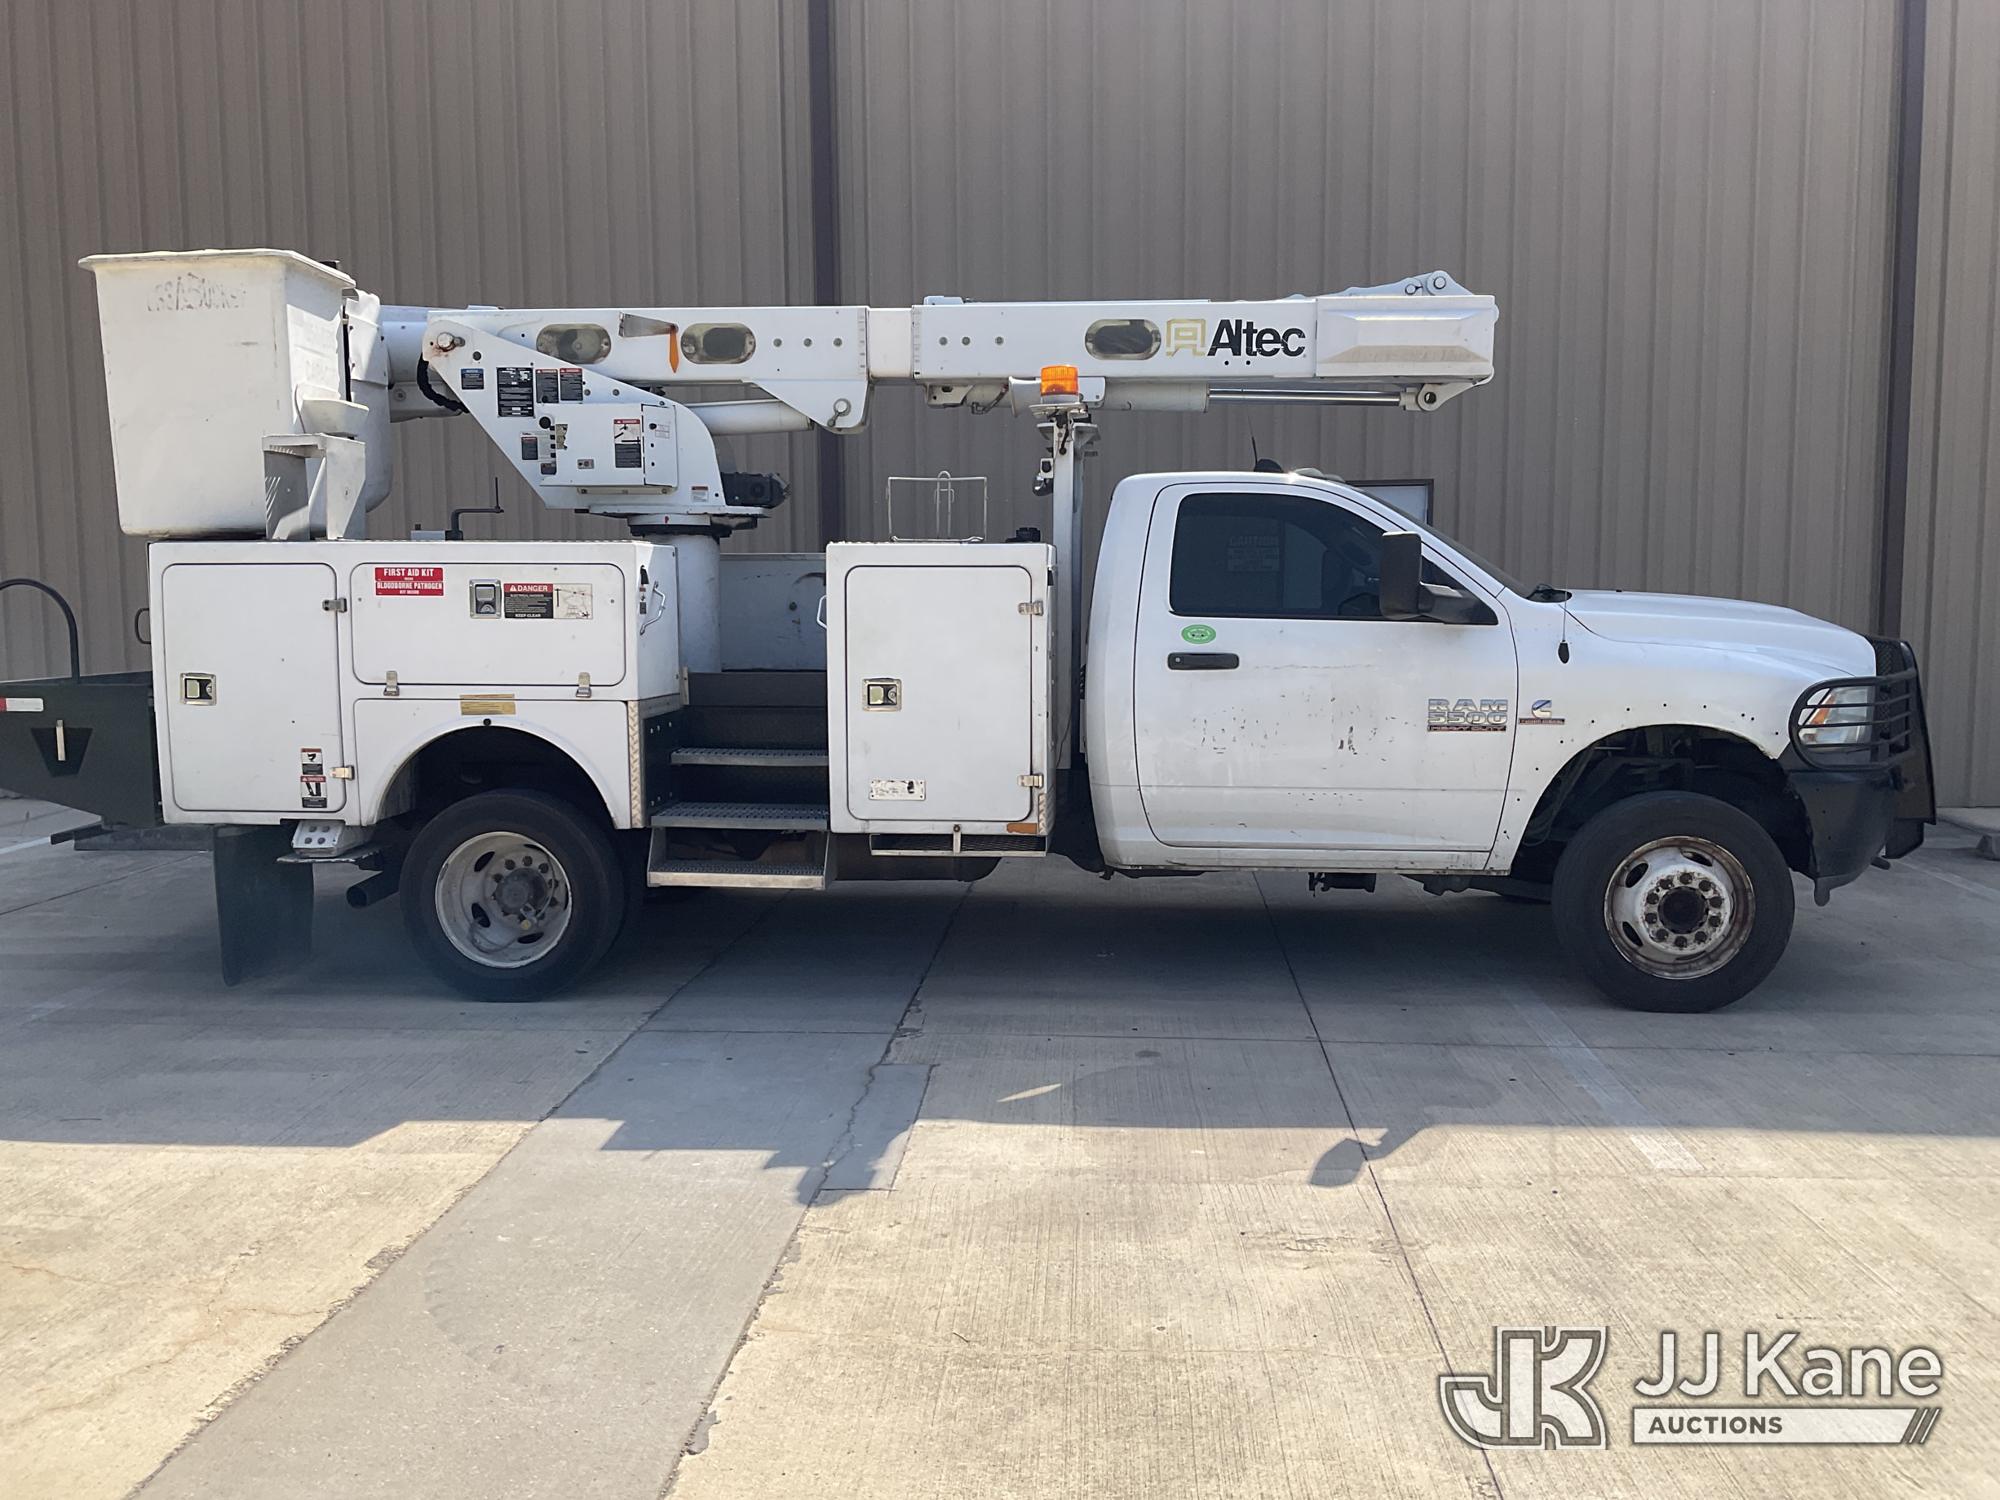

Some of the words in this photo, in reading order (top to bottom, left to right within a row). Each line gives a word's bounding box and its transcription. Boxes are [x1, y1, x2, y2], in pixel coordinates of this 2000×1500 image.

[1207, 319, 1306, 357] Altec
[383, 568, 406, 576] FIRST
[407, 568, 420, 576] AID
[422, 568, 434, 576] KIT
[414, 582, 442, 590] PATHOGEN
[1428, 698, 1508, 713] RAM
[1428, 711, 1508, 725] 5500
